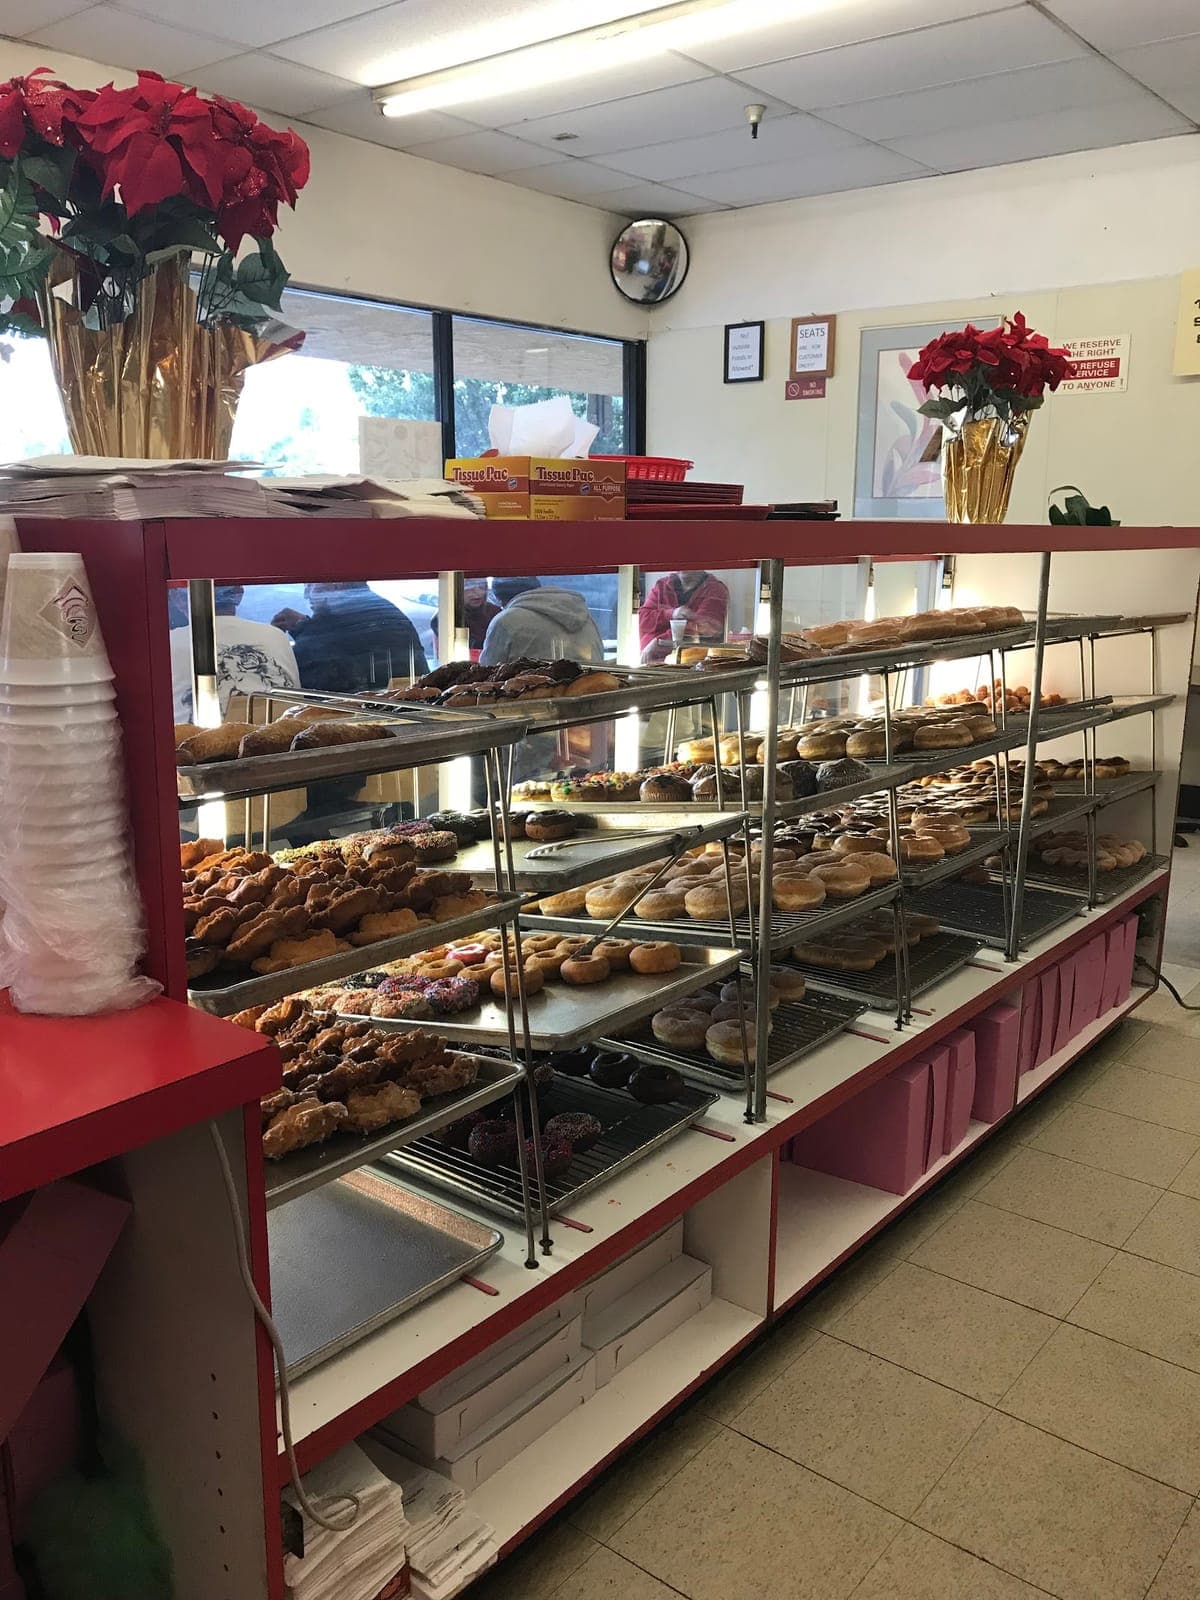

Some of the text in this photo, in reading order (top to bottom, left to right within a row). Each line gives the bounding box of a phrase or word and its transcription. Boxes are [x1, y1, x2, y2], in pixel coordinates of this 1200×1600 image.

[799, 327, 825, 339] SEATS
[1062, 339, 1122, 350] WE RESERVE
[1070, 348, 1116, 358] HE RIGHT
[1080, 360, 1116, 370] REFUSE
[1077, 380, 1116, 390] ANYONE
[802, 388, 823, 396] SMOKING
